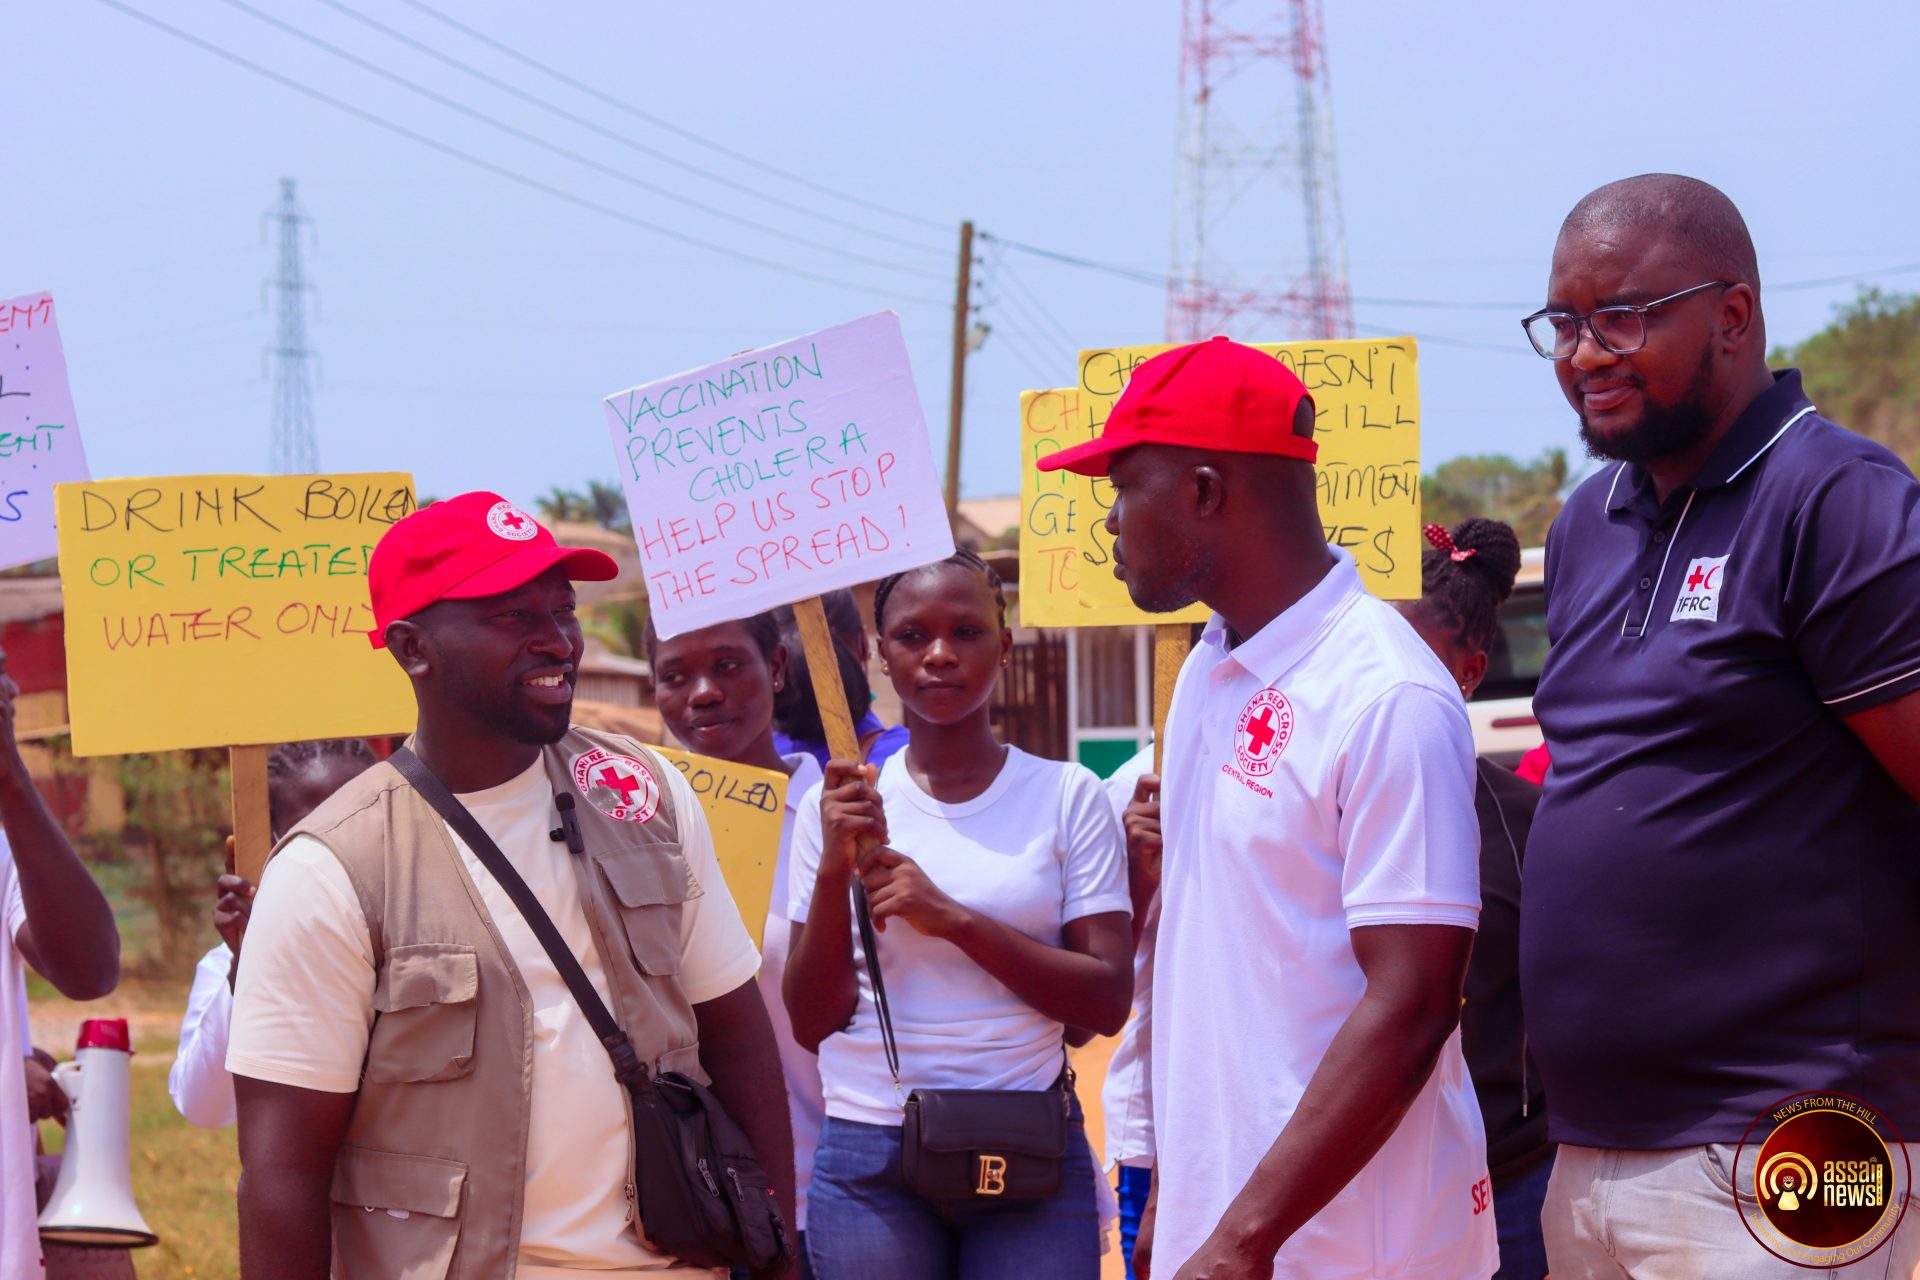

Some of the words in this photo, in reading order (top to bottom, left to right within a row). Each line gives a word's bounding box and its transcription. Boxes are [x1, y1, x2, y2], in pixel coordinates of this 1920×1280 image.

[605, 342, 823, 433] VACCINATION
[625, 399, 808, 482] PREVENTS
[688, 422, 868, 502] CHOLERA
[80, 484, 282, 533] DRINK
[640, 502, 737, 560] HELP
[752, 491, 796, 532] US
[810, 452, 896, 509] STOP
[90, 554, 165, 589] OR
[650, 561, 716, 610] THE
[103, 606, 262, 650] WATER
[276, 602, 374, 638] ONL
[1677, 596, 1712, 614] IFRC
[1237, 694, 1264, 733] GHANA
[1267, 692, 1285, 710] RED
[1272, 712, 1290, 756] CROSS
[1222, 764, 1246, 786] CENTRAL
[1246, 779, 1274, 799] REGION
[1237, 745, 1269, 773] SOCIETY
